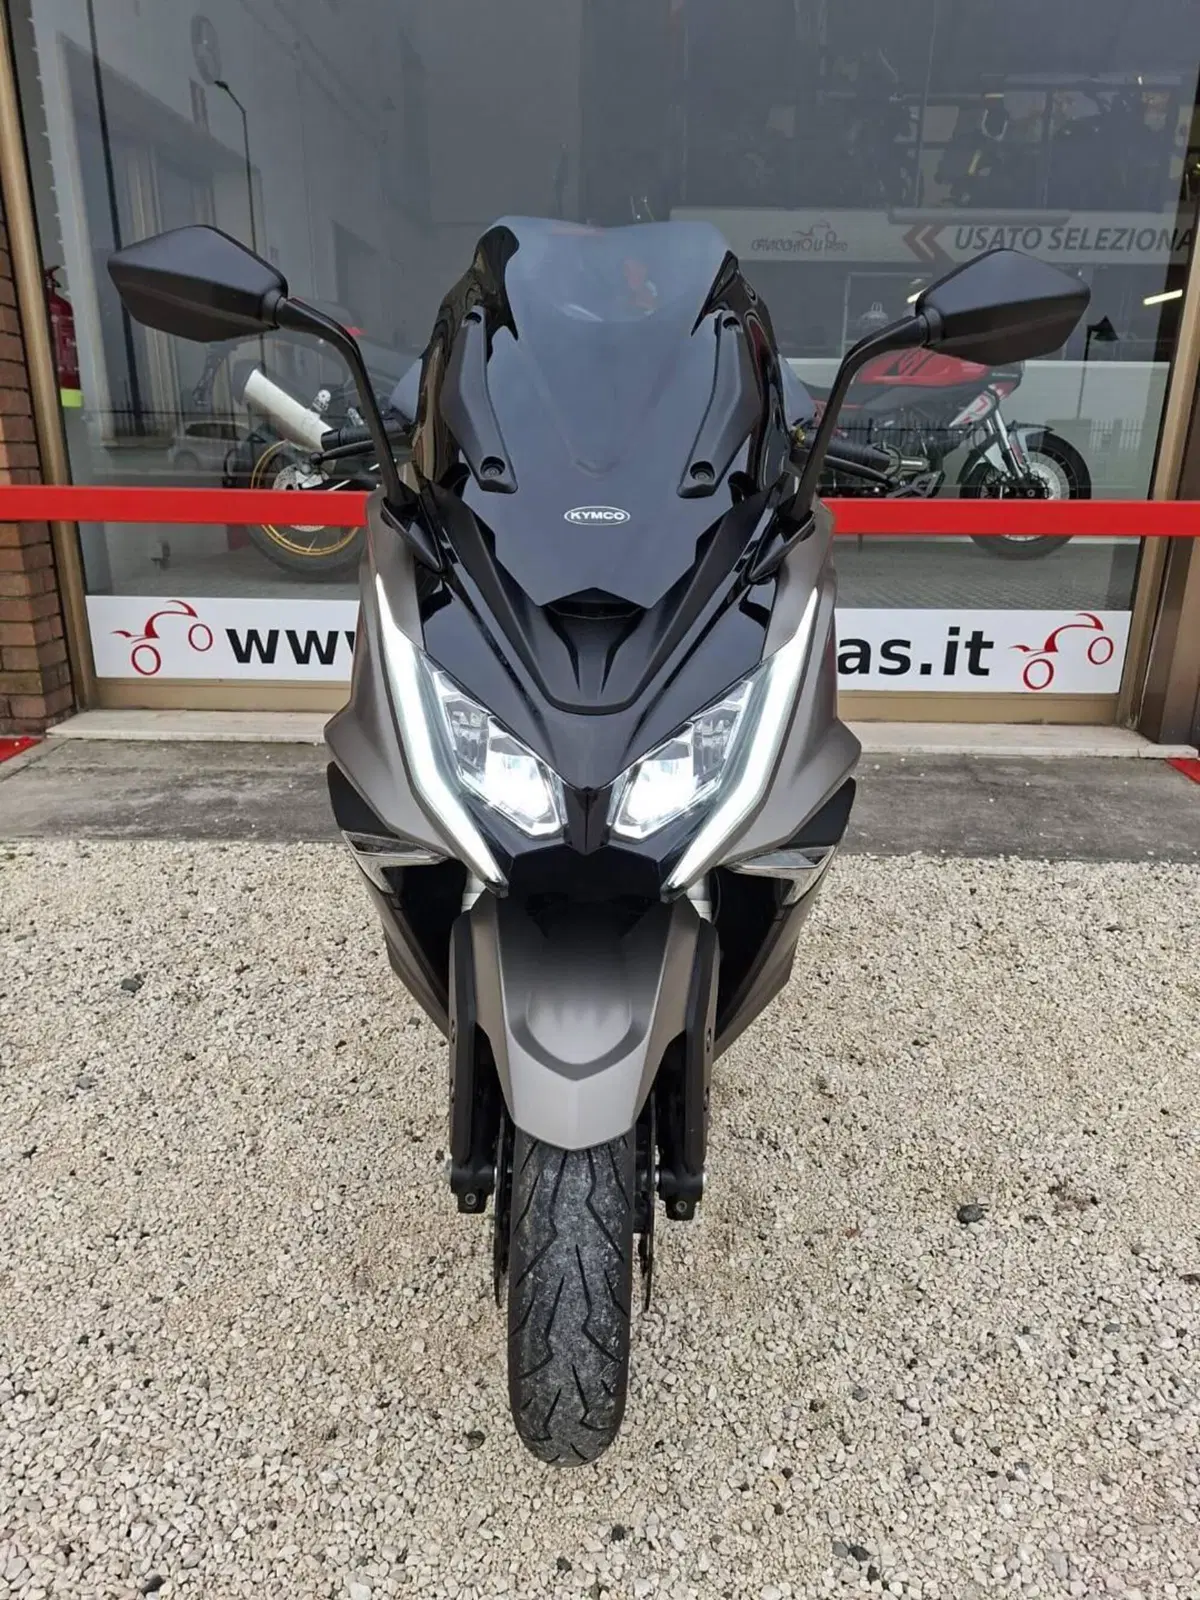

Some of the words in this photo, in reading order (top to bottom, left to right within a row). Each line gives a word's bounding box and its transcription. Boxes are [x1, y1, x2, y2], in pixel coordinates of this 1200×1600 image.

[955, 227, 1042, 250] USATO
[570, 511, 625, 520] KYMCO
[225, 628, 355, 665] ww
